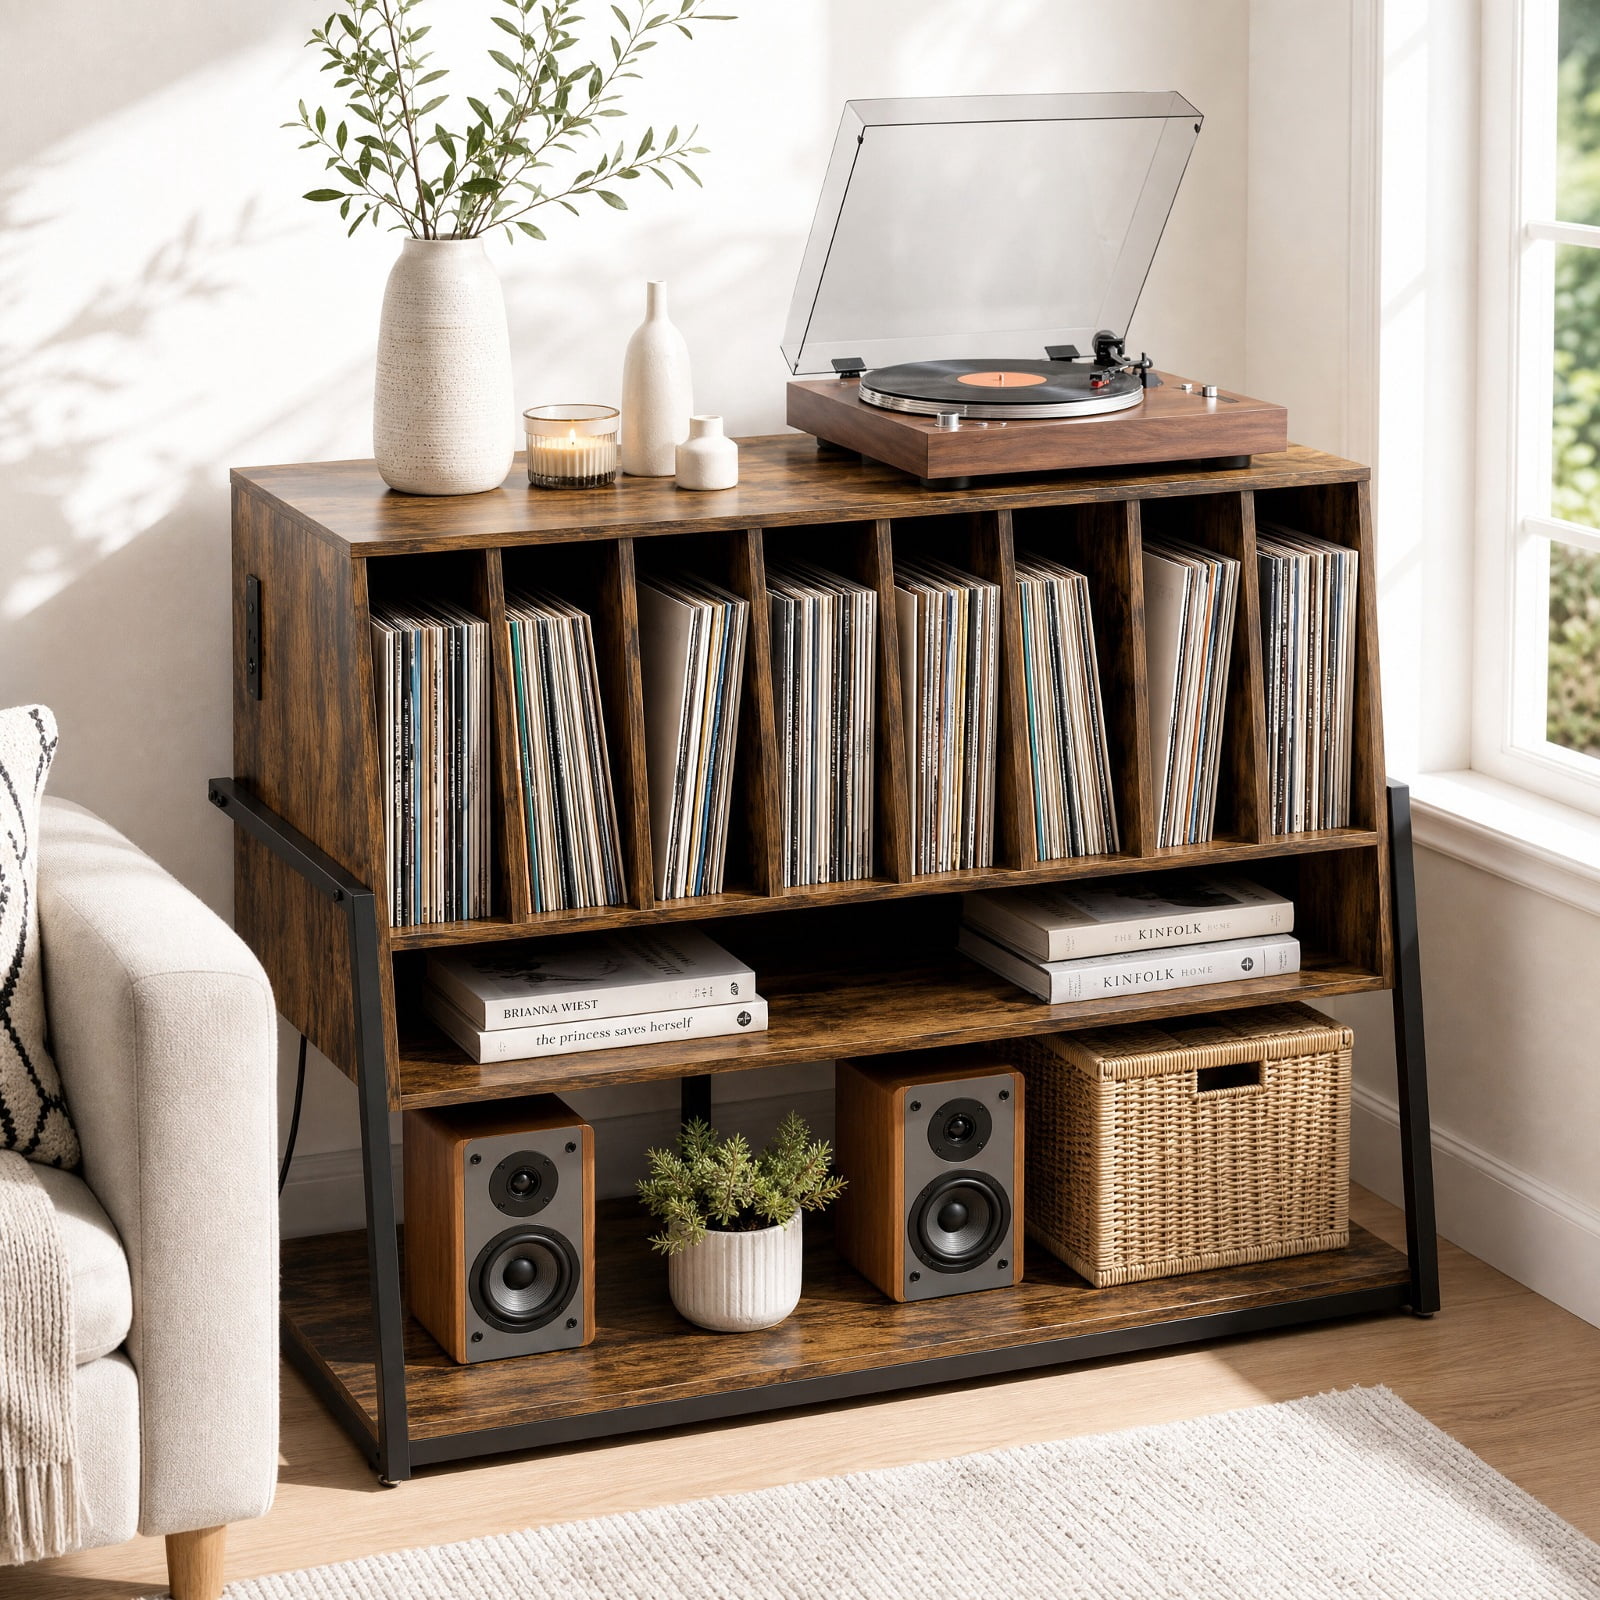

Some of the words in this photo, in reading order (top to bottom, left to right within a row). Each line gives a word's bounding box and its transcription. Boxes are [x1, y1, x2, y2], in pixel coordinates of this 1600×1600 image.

[1138, 923, 1202, 940] KINFOLK
[1103, 968, 1175, 988] KINFOLK
[1181, 965, 1213, 977] HOME
[503, 1004, 558, 1019] BRIANNA
[561, 999, 598, 1012] WIEST
[536, 1033, 556, 1046] the
[559, 1028, 611, 1046] princess
[614, 1024, 647, 1037] saves
[650, 1017, 693, 1033] herself
